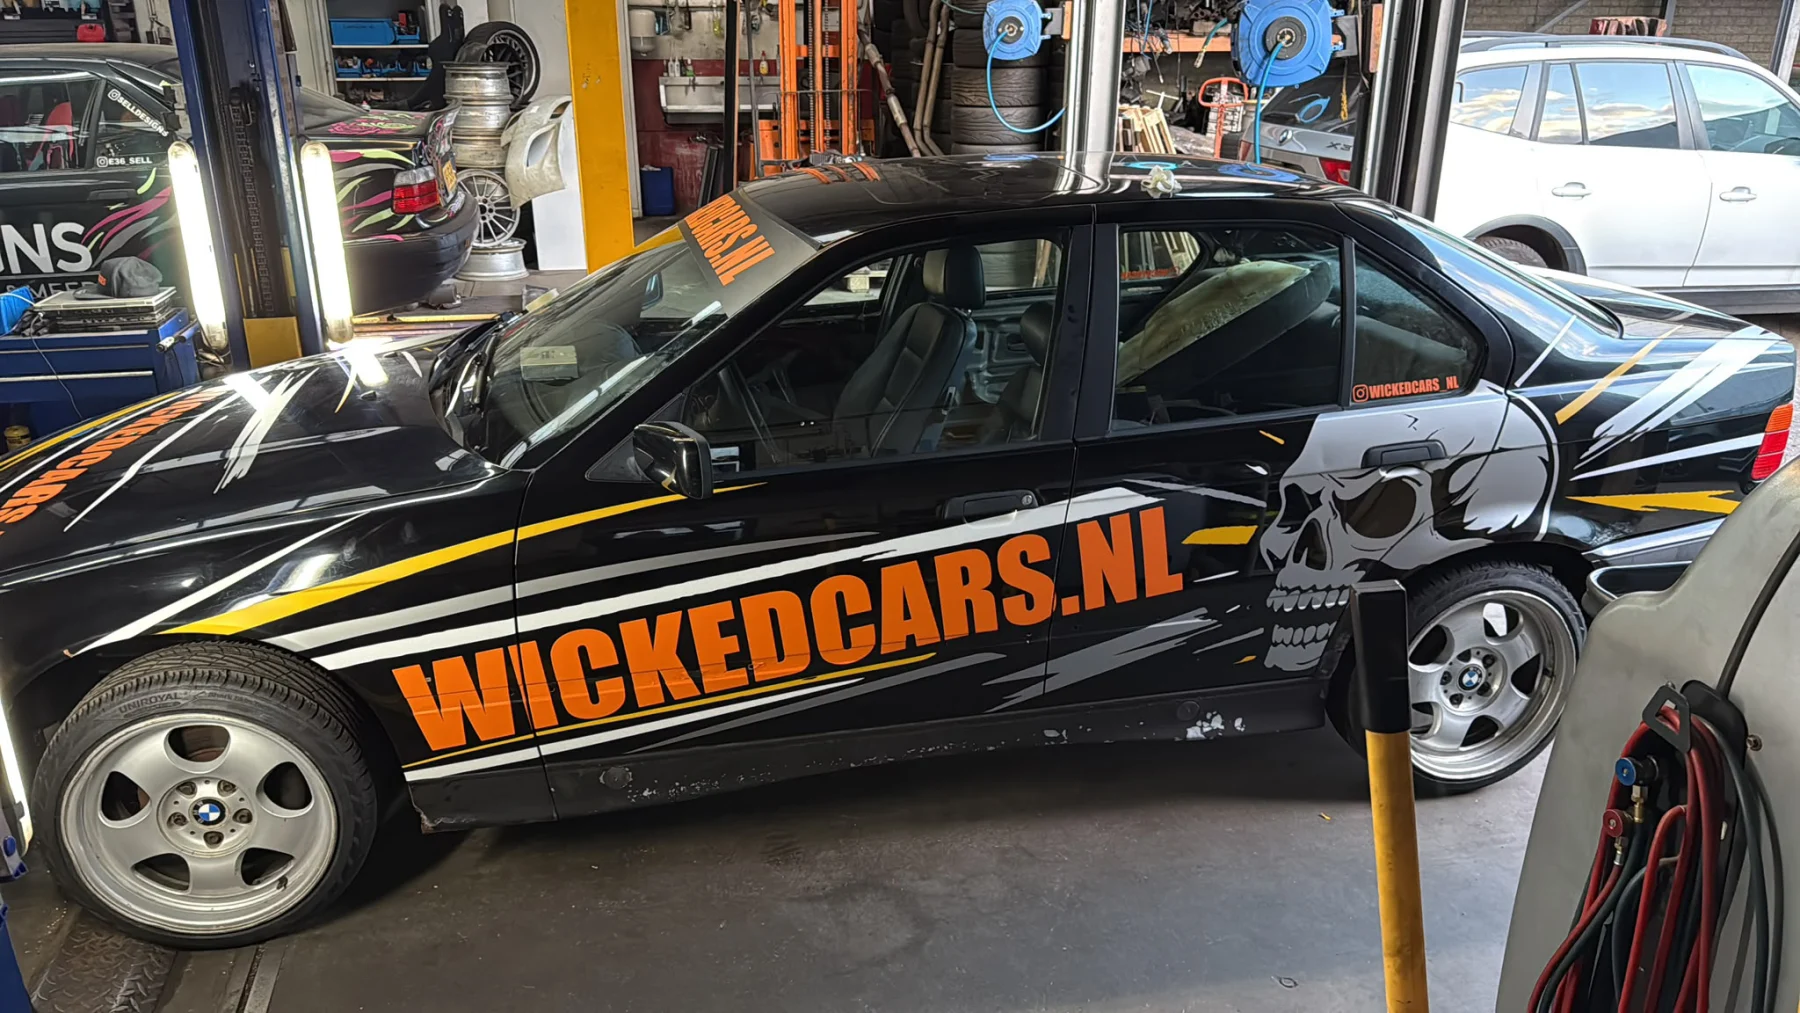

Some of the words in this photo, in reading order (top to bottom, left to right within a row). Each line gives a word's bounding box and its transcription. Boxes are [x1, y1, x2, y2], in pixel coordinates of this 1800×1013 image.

[117, 96, 169, 137] SELLDESIGNS
[1326, 141, 1352, 151] X3
[108, 156, 152, 165] E36_SELL
[0, 221, 92, 273] NS
[1369, 376, 1459, 399] WICKEDCARS_NL
[391, 506, 1184, 750] WICKEDCARS.NL
[118, 692, 180, 714] UNIROYAL
